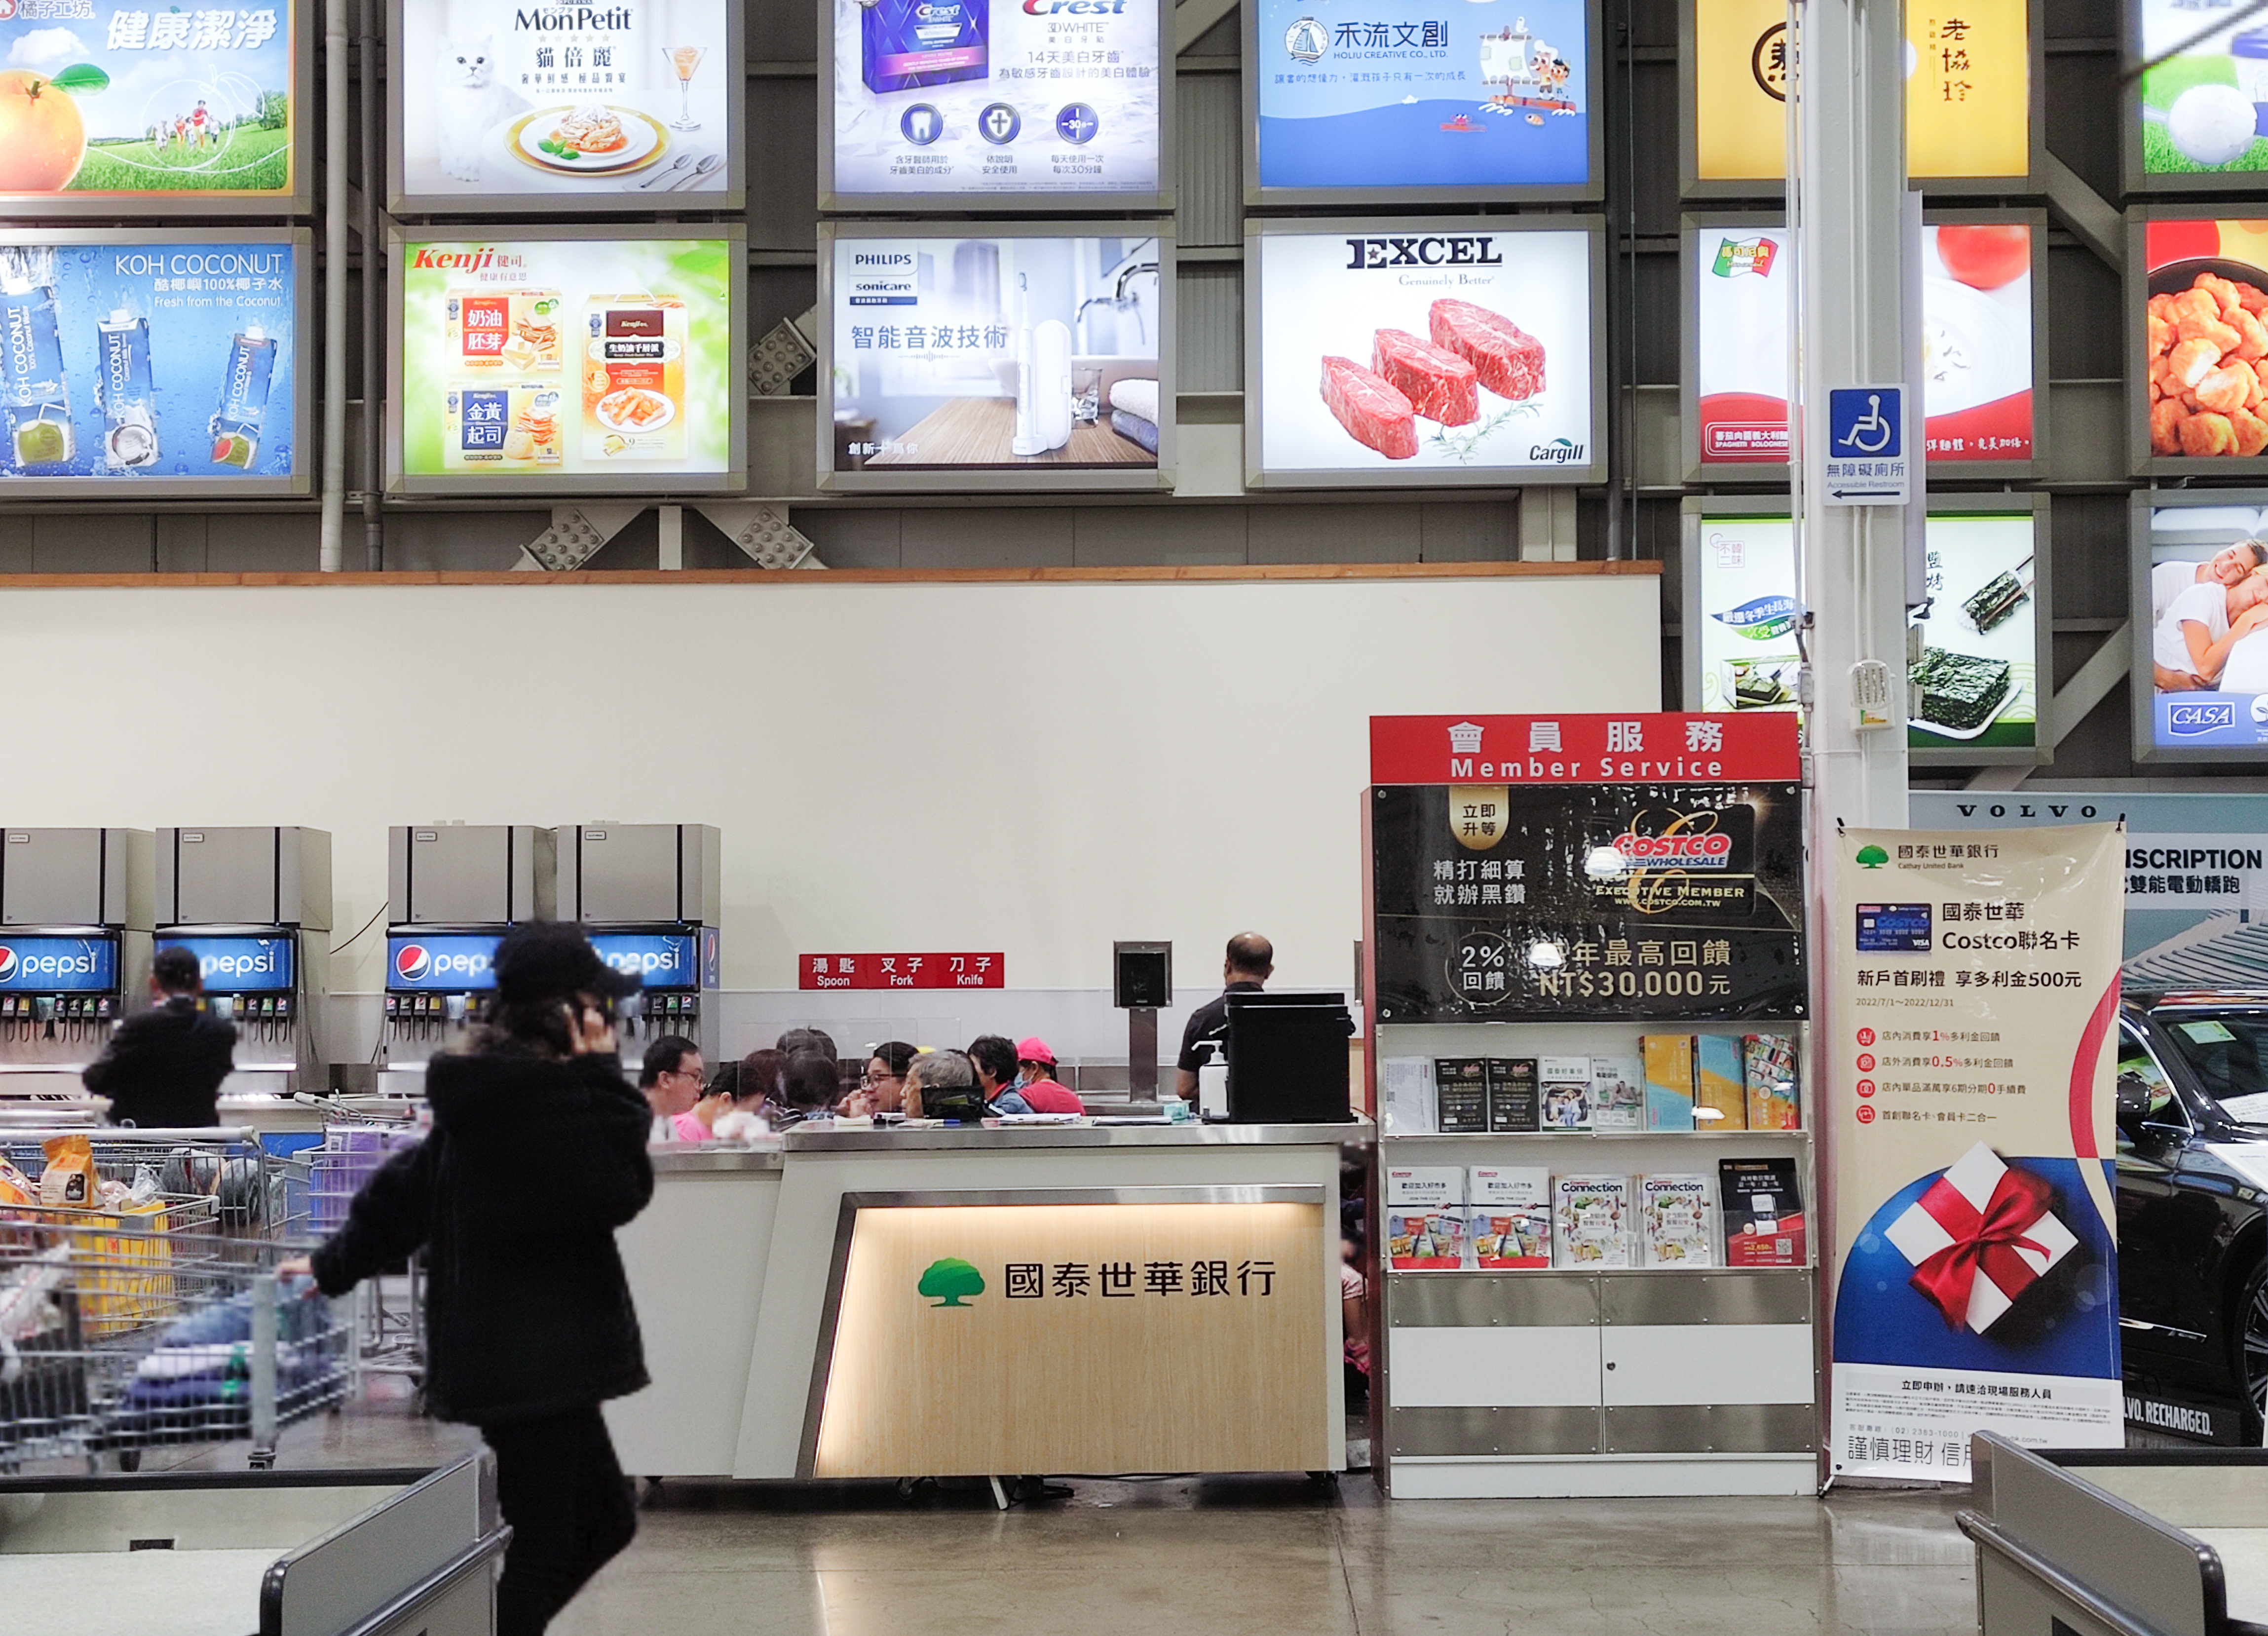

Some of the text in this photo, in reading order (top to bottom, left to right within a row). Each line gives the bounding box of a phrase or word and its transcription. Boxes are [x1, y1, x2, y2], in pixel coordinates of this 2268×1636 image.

[20, 0, 92, 18] 橘子工坊
[916, 4, 961, 17] Crest
[1022, 0, 1127, 15] Crest
[107, 10, 277, 50] 健康潔淨
[1334, 21, 1448, 48] 禾流文創
[535, 46, 611, 68] 貓倍麗
[1941, 18, 1972, 102] 老協珍
[982, 165, 1018, 175] 安全使用
[413, 248, 494, 274] Kenji
[496, 254, 522, 268] 健司
[855, 254, 912, 266] PHILIPS
[1346, 237, 1503, 269] EXCEL
[115, 253, 283, 275] KOH COCONUT
[154, 278, 282, 291] 酷椰嶼100%椰子水
[856, 280, 911, 292] sonicare
[1399, 273, 1492, 289] Genuinely Better
[154, 297, 184, 307] Fresh
[186, 297, 212, 307] from
[215, 296, 233, 306] the
[468, 309, 502, 327] 奶油
[468, 332, 502, 350] 胚芽
[851, 325, 1007, 349] 智能音波技術
[7, 307, 33, 408] KOH COCONUT
[108, 334, 124, 391] COCONUT
[227, 346, 250, 421] KOH COCONUT
[113, 393, 124, 419] KOH
[467, 402, 502, 421] 金黃
[467, 425, 502, 444] 起司
[1529, 445, 1584, 463] Cargill
[1826, 463, 1905, 477] 無障礙廁所
[2172, 707, 2230, 725] CASA
[1447, 721, 1724, 754] 會員服務
[1451, 757, 1723, 778] Member Service
[1462, 804, 1496, 819] 立即
[1957, 804, 2097, 818] VOLVO
[1463, 822, 1497, 837] 升等
[1611, 834, 1730, 857] COSTCO
[1898, 844, 1999, 859] 國泰世華銀行
[1433, 859, 1525, 880] 精打細算
[1646, 857, 1726, 867] WHOLESALE
[1595, 886, 1745, 897] EXECUTIVE MEMBER
[2124, 875, 2240, 894] 雙能電動轎跑
[1434, 884, 1526, 905] 就辦黑鑽
[1942, 902, 2025, 922] 國泰世華
[1942, 931, 2080, 950] Costco聯名卡
[22, 952, 96, 978] pepsi
[198, 951, 274, 979] pepsi
[434, 953, 488, 977] pep
[812, 956, 991, 973] 湯匙 叉子 刀子
[1462, 946, 1505, 968] 2%
[817, 974, 983, 988] Spoon Fork Knife
[1463, 971, 1505, 991] 回饋
[1857, 970, 2082, 988] 新戶首刷禮 享多利金500元
[1561, 1182, 1623, 1192] Connection
[1645, 1181, 1703, 1191] Connection
[1005, 1261, 1276, 1298] 國泰世華銀行
[2145, 1401, 2213, 1437] RECHARGED.
[1848, 1436, 1934, 1465] 謹慎理財
